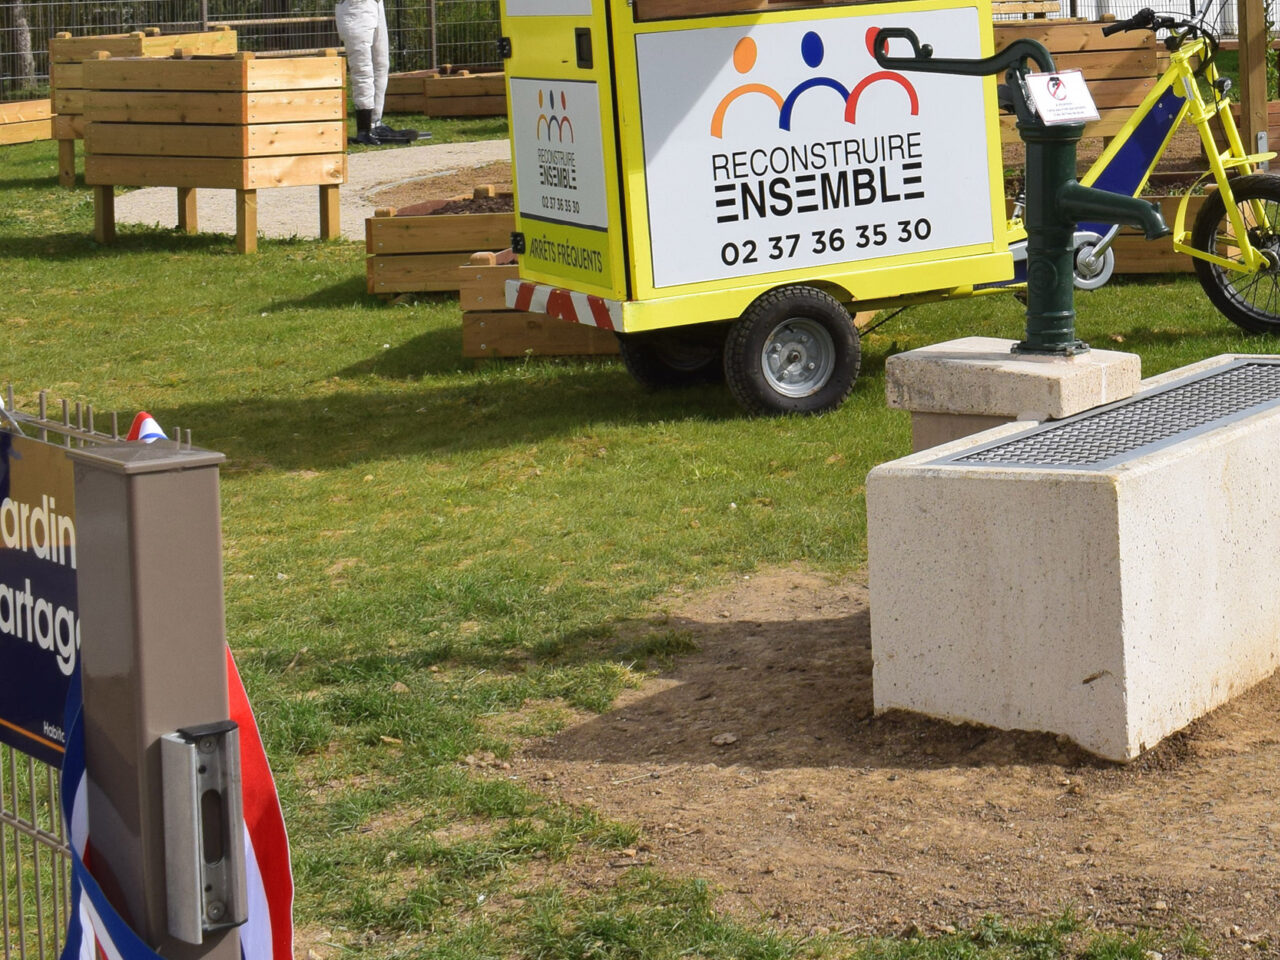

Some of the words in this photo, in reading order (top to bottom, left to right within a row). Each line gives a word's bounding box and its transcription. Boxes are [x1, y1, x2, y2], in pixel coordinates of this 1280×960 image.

[538, 148, 576, 168] RECONSTRUIRE
[539, 165, 577, 190] ENSEMBLE
[712, 132, 922, 181] RECONSTRUIRE
[542, 195, 549, 209] 02
[549, 197, 556, 210] 37
[557, 198, 564, 211] 36
[564, 200, 571, 213] 35
[572, 201, 580, 214] 30
[714, 161, 925, 223] ENSEMBLE
[529, 234, 556, 263] ARRÊTS
[557, 239, 603, 273] FRÉQUENTS
[721, 240, 758, 266] 02
[768, 233, 800, 260] 37
[811, 228, 845, 254] 36
[855, 223, 887, 248] 35
[898, 218, 931, 243] 30
[0, 578, 81, 676] artag
